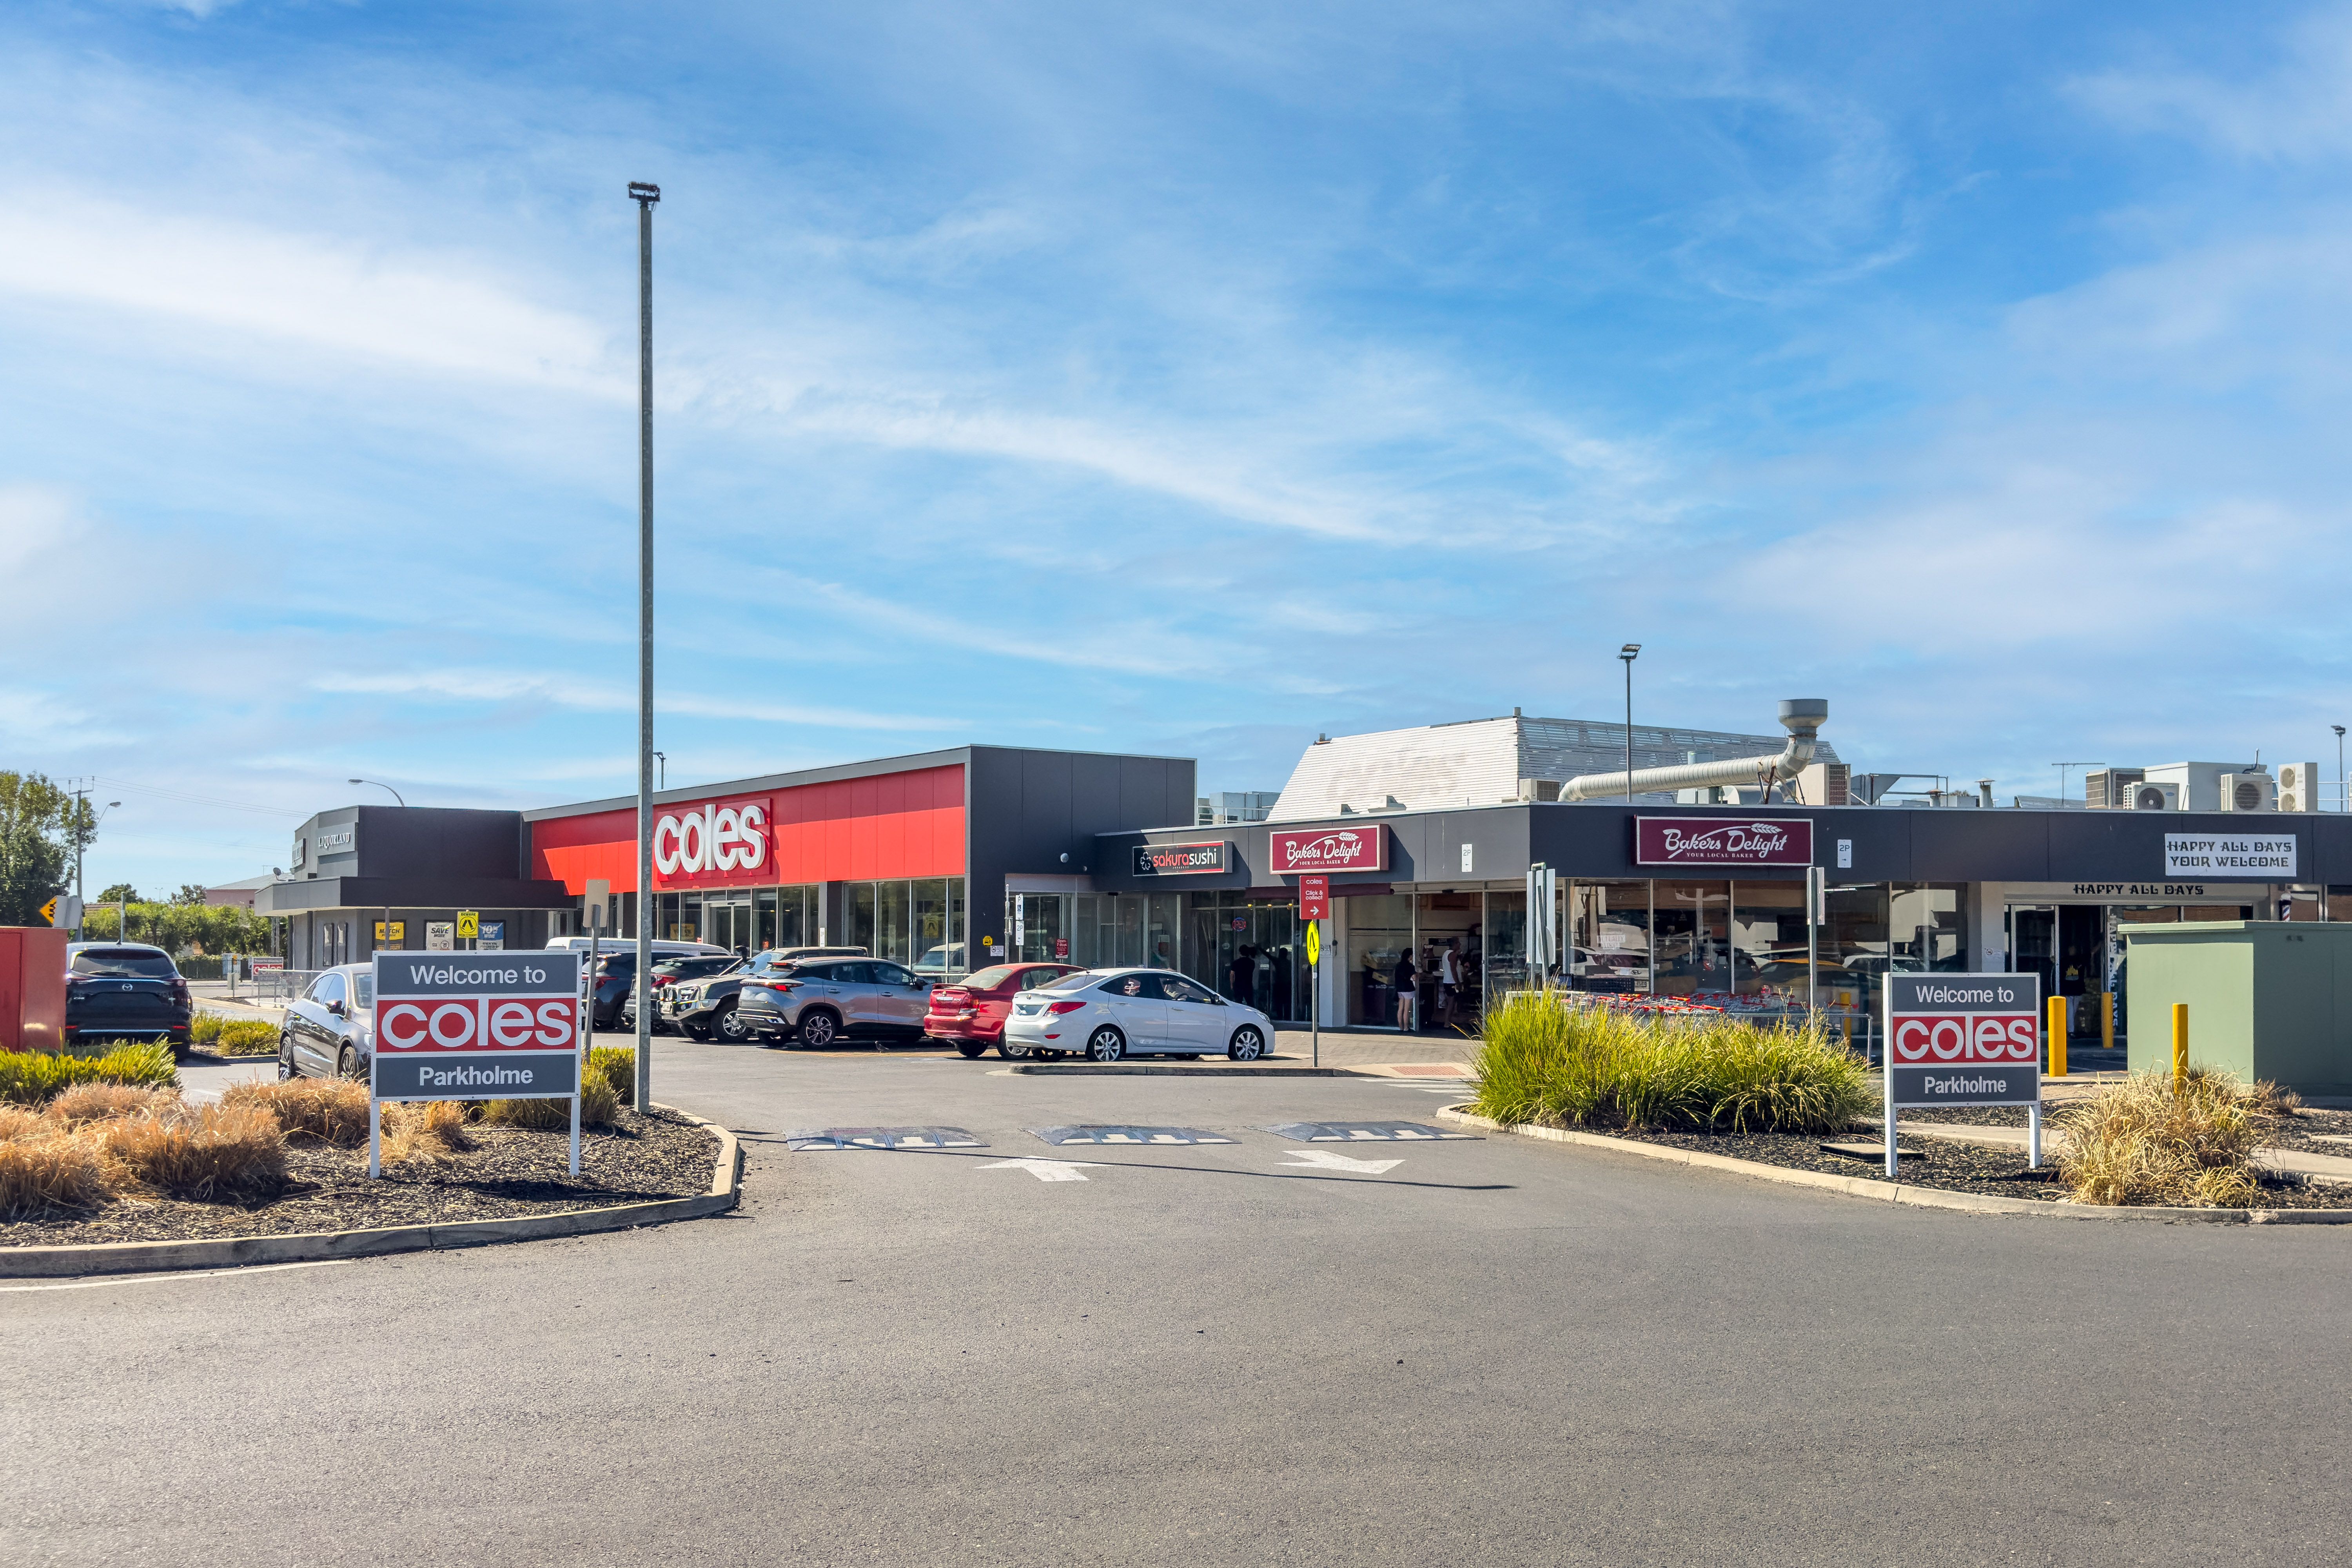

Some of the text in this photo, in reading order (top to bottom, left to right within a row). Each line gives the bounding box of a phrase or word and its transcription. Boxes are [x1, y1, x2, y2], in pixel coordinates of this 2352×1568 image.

[318, 833, 350, 848] LIQUORLAND
[654, 804, 766, 875] coles
[1663, 829, 1787, 858] Bakers Delight
[2167, 841, 2292, 852] HAPPY ALL DAYS
[1153, 848, 1216, 867] sakurasushi
[1285, 839, 1362, 864] Bakers Delight
[2170, 856, 2288, 867] YOUR WELCOME
[2073, 884, 2204, 895] HAPPY ALL DAYS
[410, 965, 546, 984] Welcome to
[1916, 985, 2014, 1003] Welcome to
[381, 998, 572, 1048] coles
[1896, 1016, 2033, 1059] coles
[419, 1065, 533, 1086] Parkholme
[1925, 1076, 2006, 1094] Parkholme
